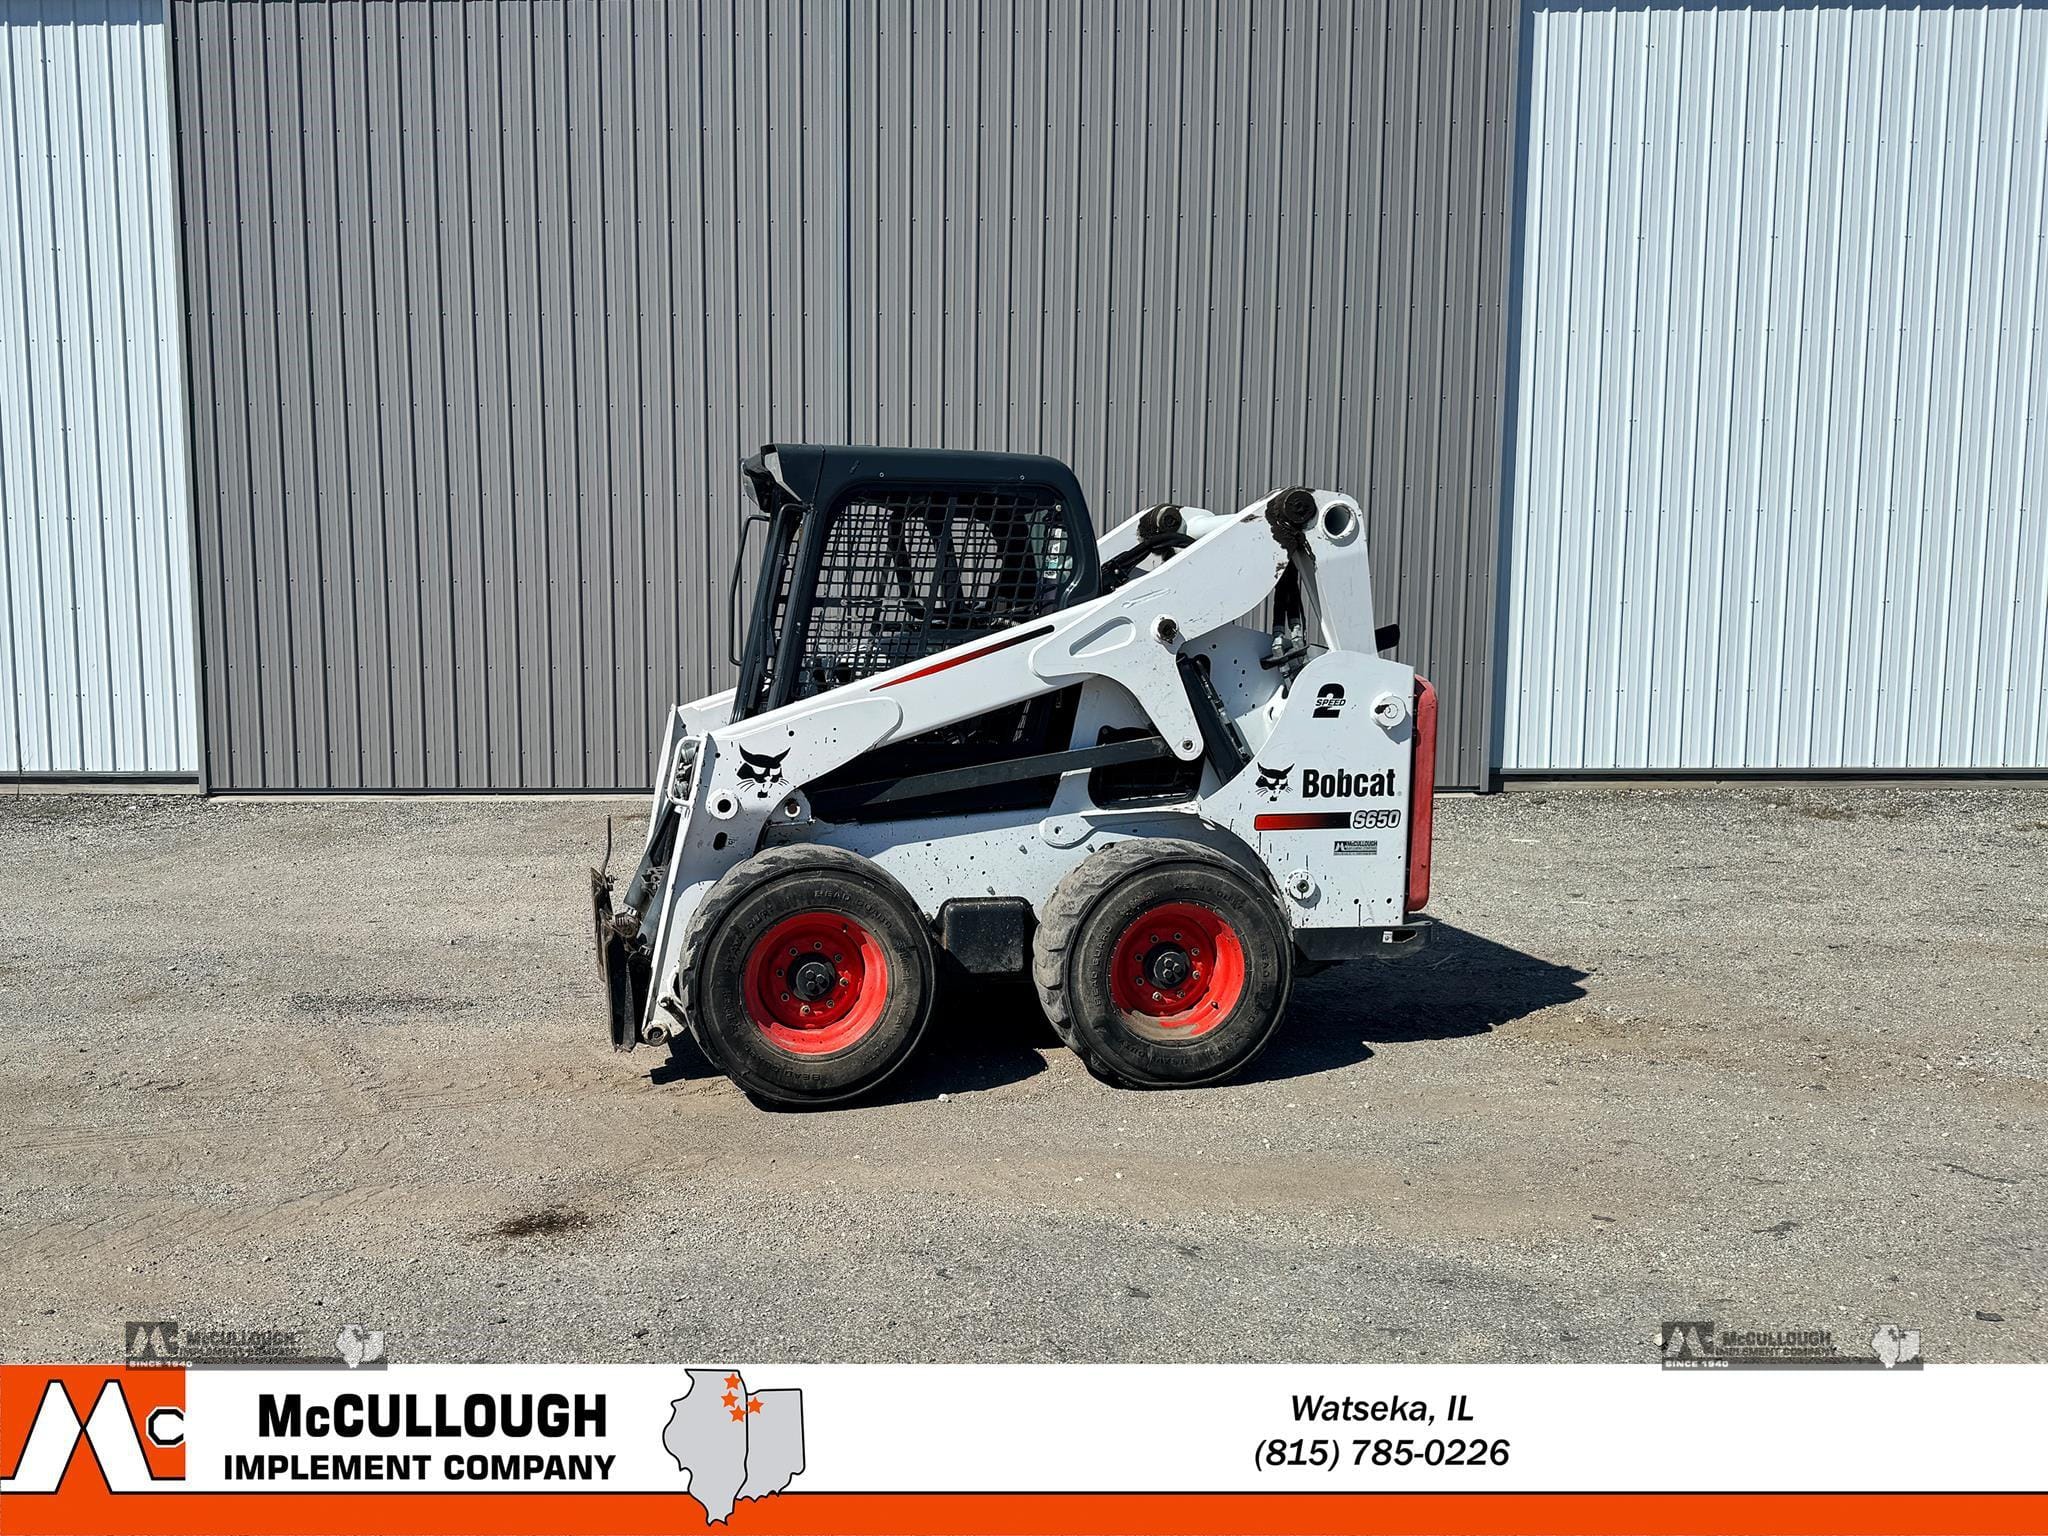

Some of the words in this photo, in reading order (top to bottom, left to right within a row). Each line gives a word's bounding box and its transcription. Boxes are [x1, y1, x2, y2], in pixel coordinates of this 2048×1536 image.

[1312, 683, 1345, 718] 2
[1315, 699, 1346, 707] SPEED
[1302, 768, 1396, 798] Bobcat
[1353, 809, 1401, 829] S650
